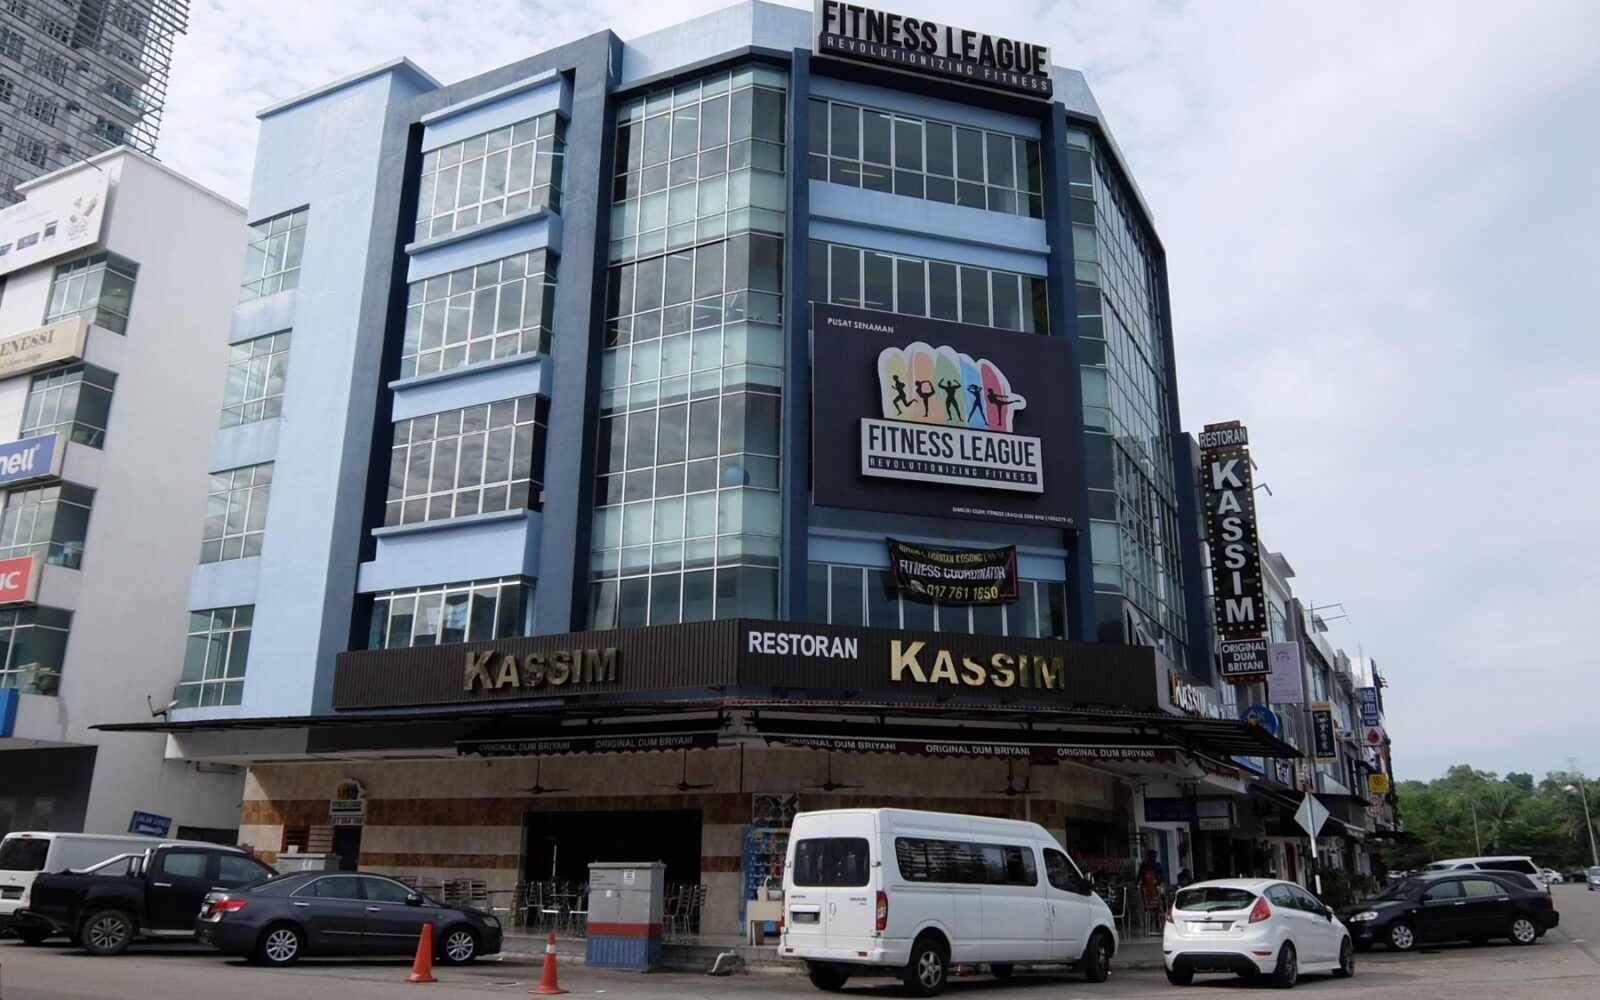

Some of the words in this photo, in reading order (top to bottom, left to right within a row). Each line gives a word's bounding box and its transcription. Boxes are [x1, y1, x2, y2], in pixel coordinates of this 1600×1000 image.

[823, 0, 938, 54] FITNESS
[946, 26, 1048, 77] LEAGUE
[826, 36, 974, 75] REVOLUTIONIZING
[984, 68, 1048, 91] FITNESS
[827, 317, 852, 329] PUSAT
[854, 320, 894, 334] SENAMAN
[868, 423, 954, 459] FITNESS
[960, 433, 1036, 468] LEAGUE
[1200, 427, 1247, 448] RESTORAN
[869, 457, 978, 477] REVOLUTIONIZING
[985, 469, 1034, 482] FITNESS
[1005, 511, 1023, 519] LEAGUE
[1211, 458, 1255, 624] KASSIM
[955, 553, 983, 564] KOSONG
[899, 560, 941, 578] FITNESS
[943, 565, 1006, 580] COORDINATOR
[927, 584, 945, 598] 017
[948, 586, 968, 599] 761
[973, 586, 999, 600] 1650
[748, 630, 858, 660] RESTORAN
[1222, 641, 1267, 654] ORIGINAL
[890, 639, 1065, 690] KASSIM
[1233, 651, 1257, 662] DUM
[464, 646, 617, 691] KASSIM
[1228, 660, 1264, 673] BRIYANI
[478, 743, 517, 752] ORIGINAL
[518, 742, 537, 751] DUM
[537, 741, 570, 750] BRIYANI
[595, 738, 636, 749] ORIGINAL
[638, 737, 658, 748] DUM
[659, 736, 693, 747] BRIYANI
[785, 737, 832, 748] ORIGINAL
[834, 739, 856, 749] DUM
[857, 740, 896, 751] BRIYANI
[925, 744, 971, 755] ORIGINAL
[972, 745, 992, 755] DUM
[993, 745, 1030, 756] BRIYANI
[1057, 747, 1098, 758] ORIGINAL
[1100, 748, 1120, 758] DUM
[1121, 749, 1155, 759] BRIYANI
